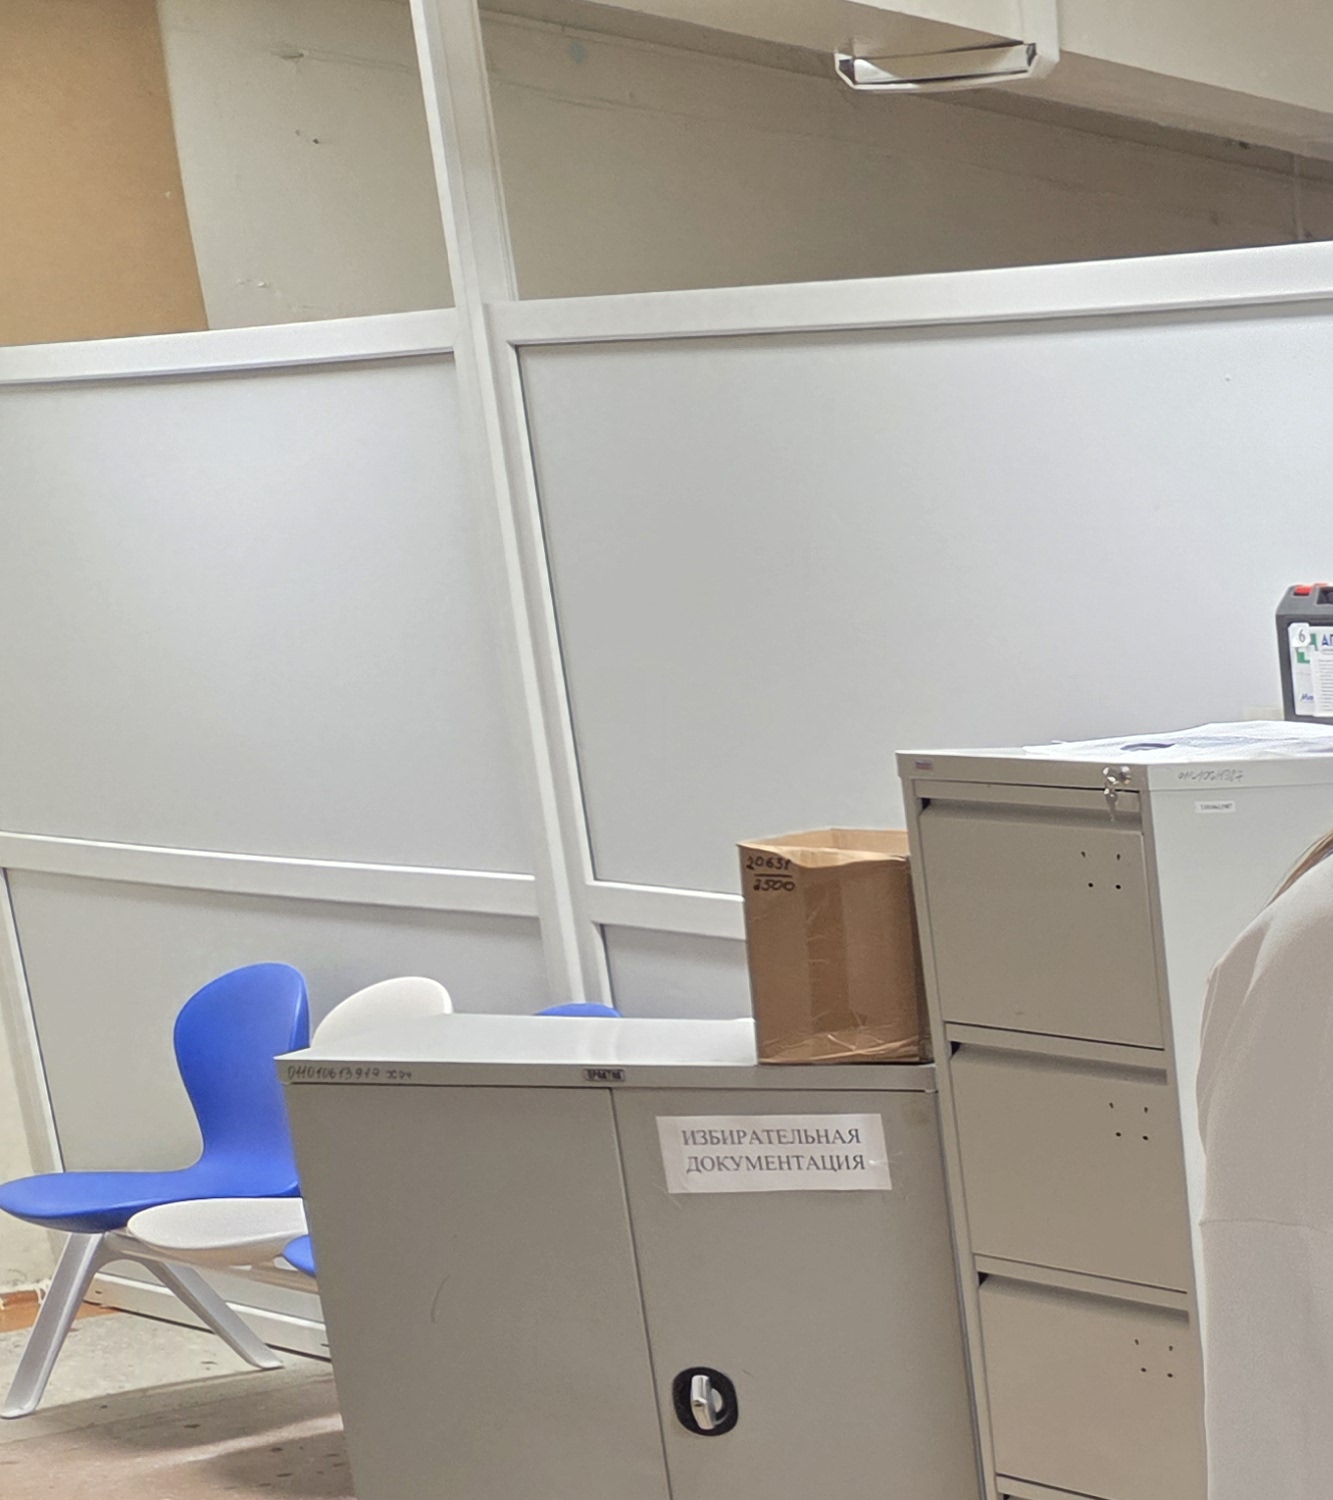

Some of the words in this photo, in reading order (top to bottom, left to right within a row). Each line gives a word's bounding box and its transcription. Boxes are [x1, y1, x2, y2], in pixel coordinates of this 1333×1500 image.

[1298, 629, 1306, 643] 6
[681, 1128, 861, 1146] ИЗБИРАТЕЛЬНАЯ
[686, 1154, 866, 1174] ДОКУМЕНТАЦИЯ
